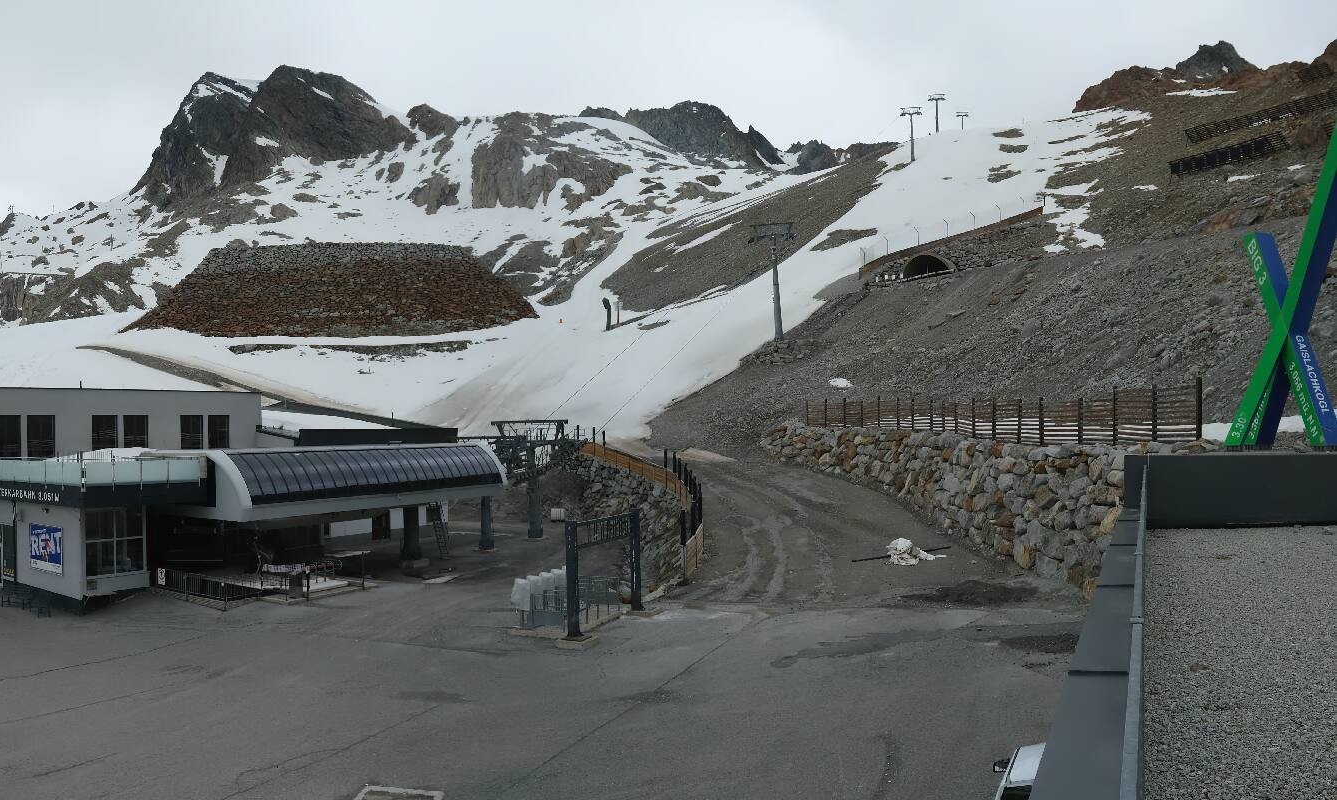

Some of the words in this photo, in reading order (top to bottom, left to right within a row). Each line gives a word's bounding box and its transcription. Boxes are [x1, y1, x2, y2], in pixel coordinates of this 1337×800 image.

[1247, 238, 1263, 271] BIG
[1258, 271, 1267, 286] 3
[1295, 335, 1330, 415] GAISLACHKOGL
[31, 532, 61, 556] RENT
